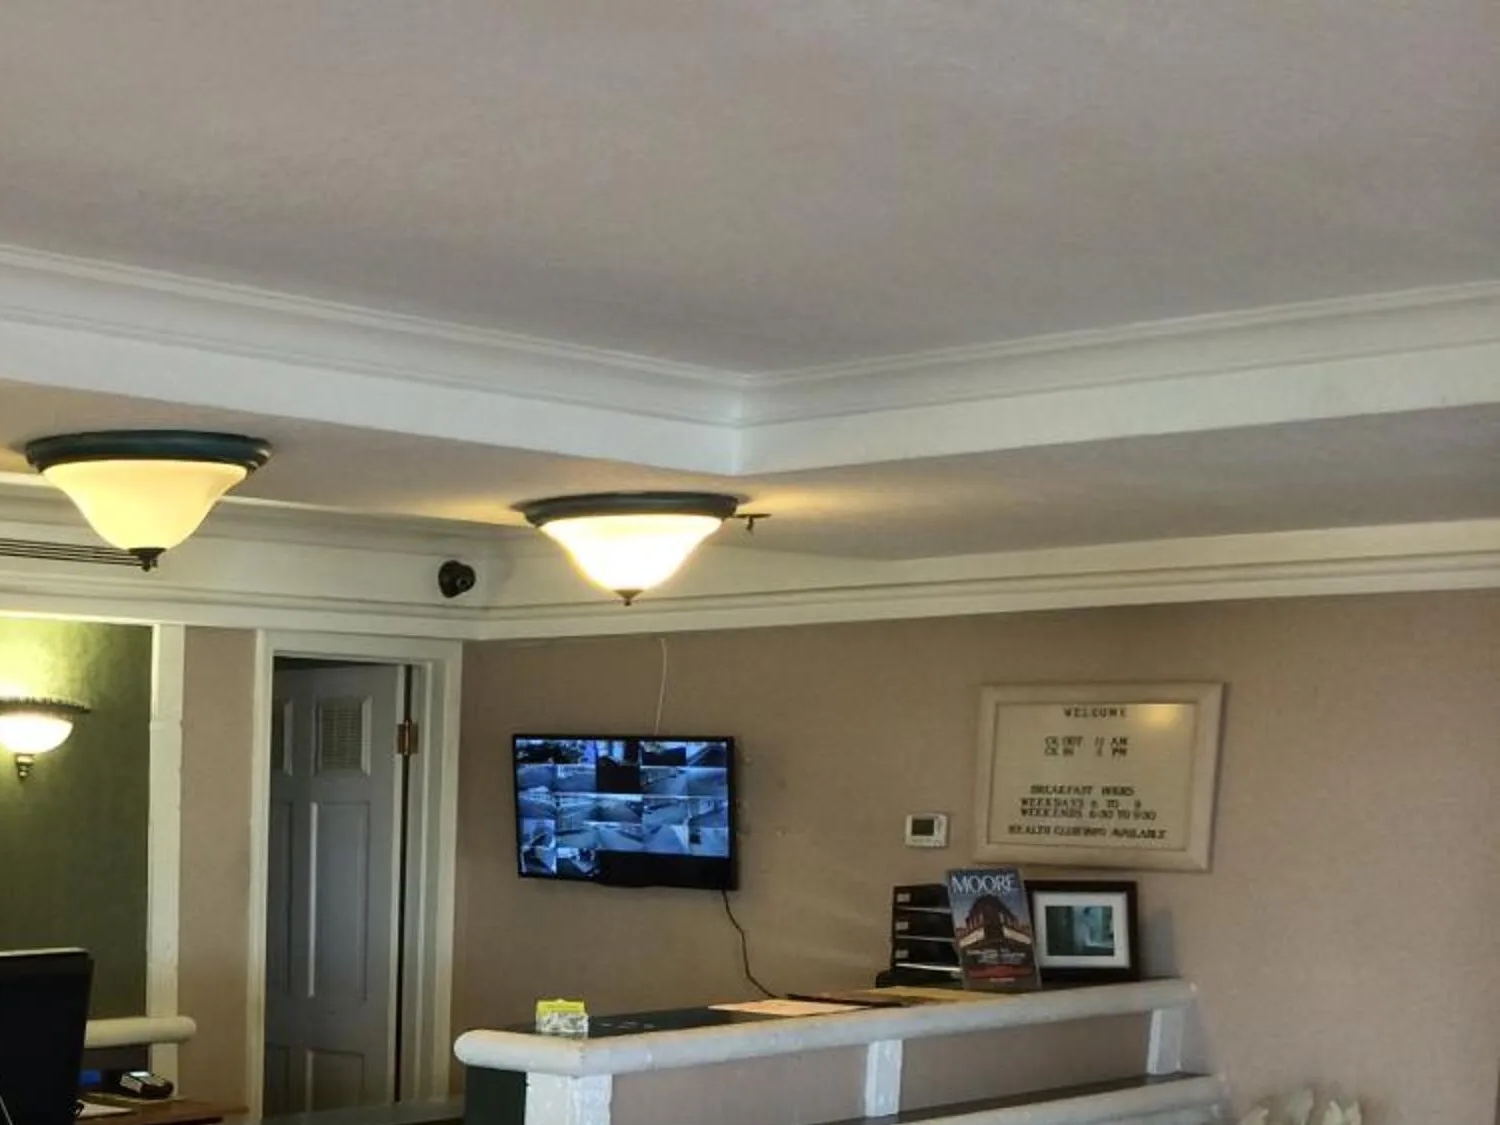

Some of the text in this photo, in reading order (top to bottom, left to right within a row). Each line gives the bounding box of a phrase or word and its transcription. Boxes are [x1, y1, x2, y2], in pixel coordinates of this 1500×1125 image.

[1063, 707, 1127, 718] WELCOME
[1030, 785, 1135, 796] BREAKFAST HOURS
[1111, 828, 1167, 839] AVAILABLE
[951, 873, 1016, 893] MOORE
